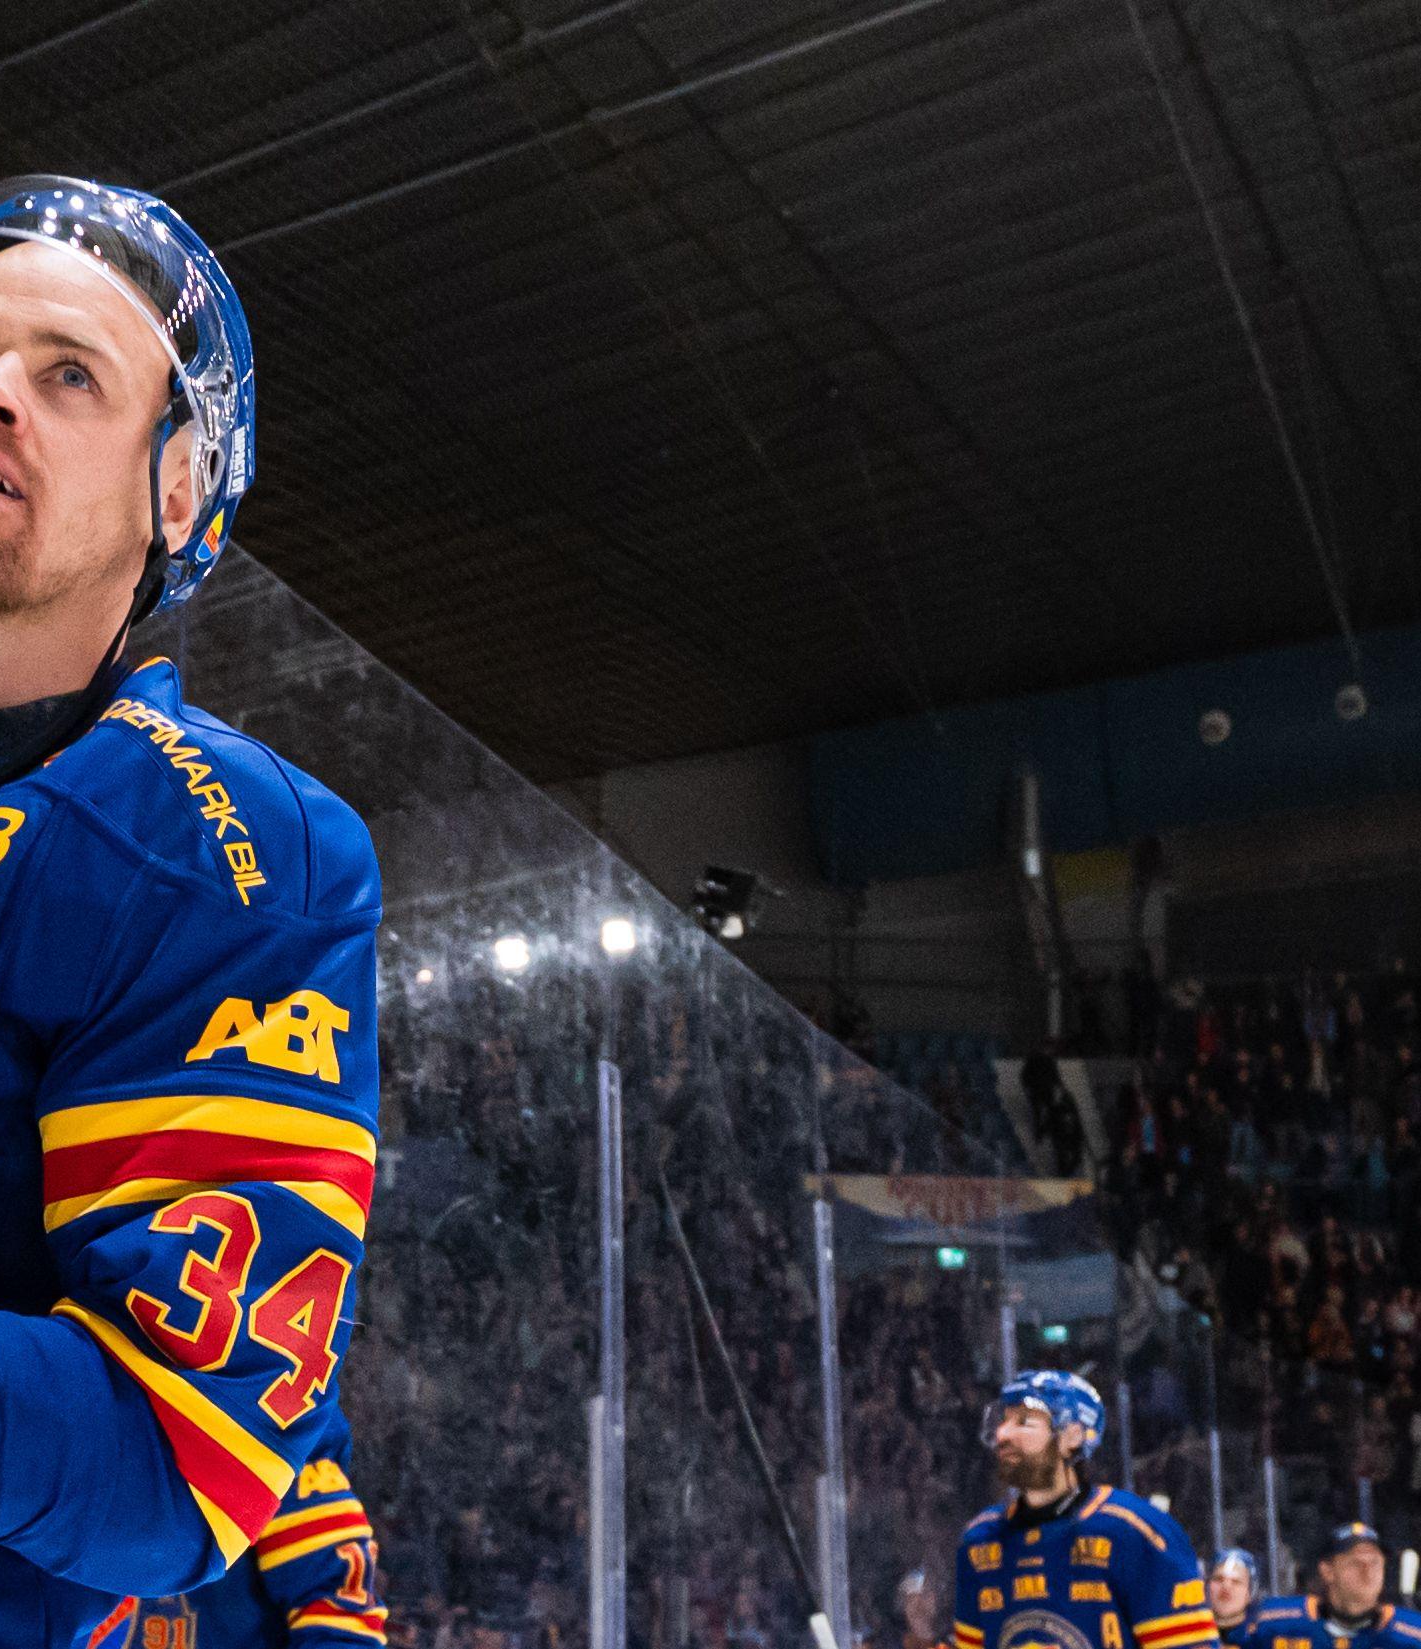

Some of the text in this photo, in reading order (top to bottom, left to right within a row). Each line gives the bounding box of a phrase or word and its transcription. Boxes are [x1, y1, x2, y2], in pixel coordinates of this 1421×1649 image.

[223, 842, 267, 906] BIL
[185, 989, 350, 1084] ABT
[126, 1190, 352, 1430] 34
